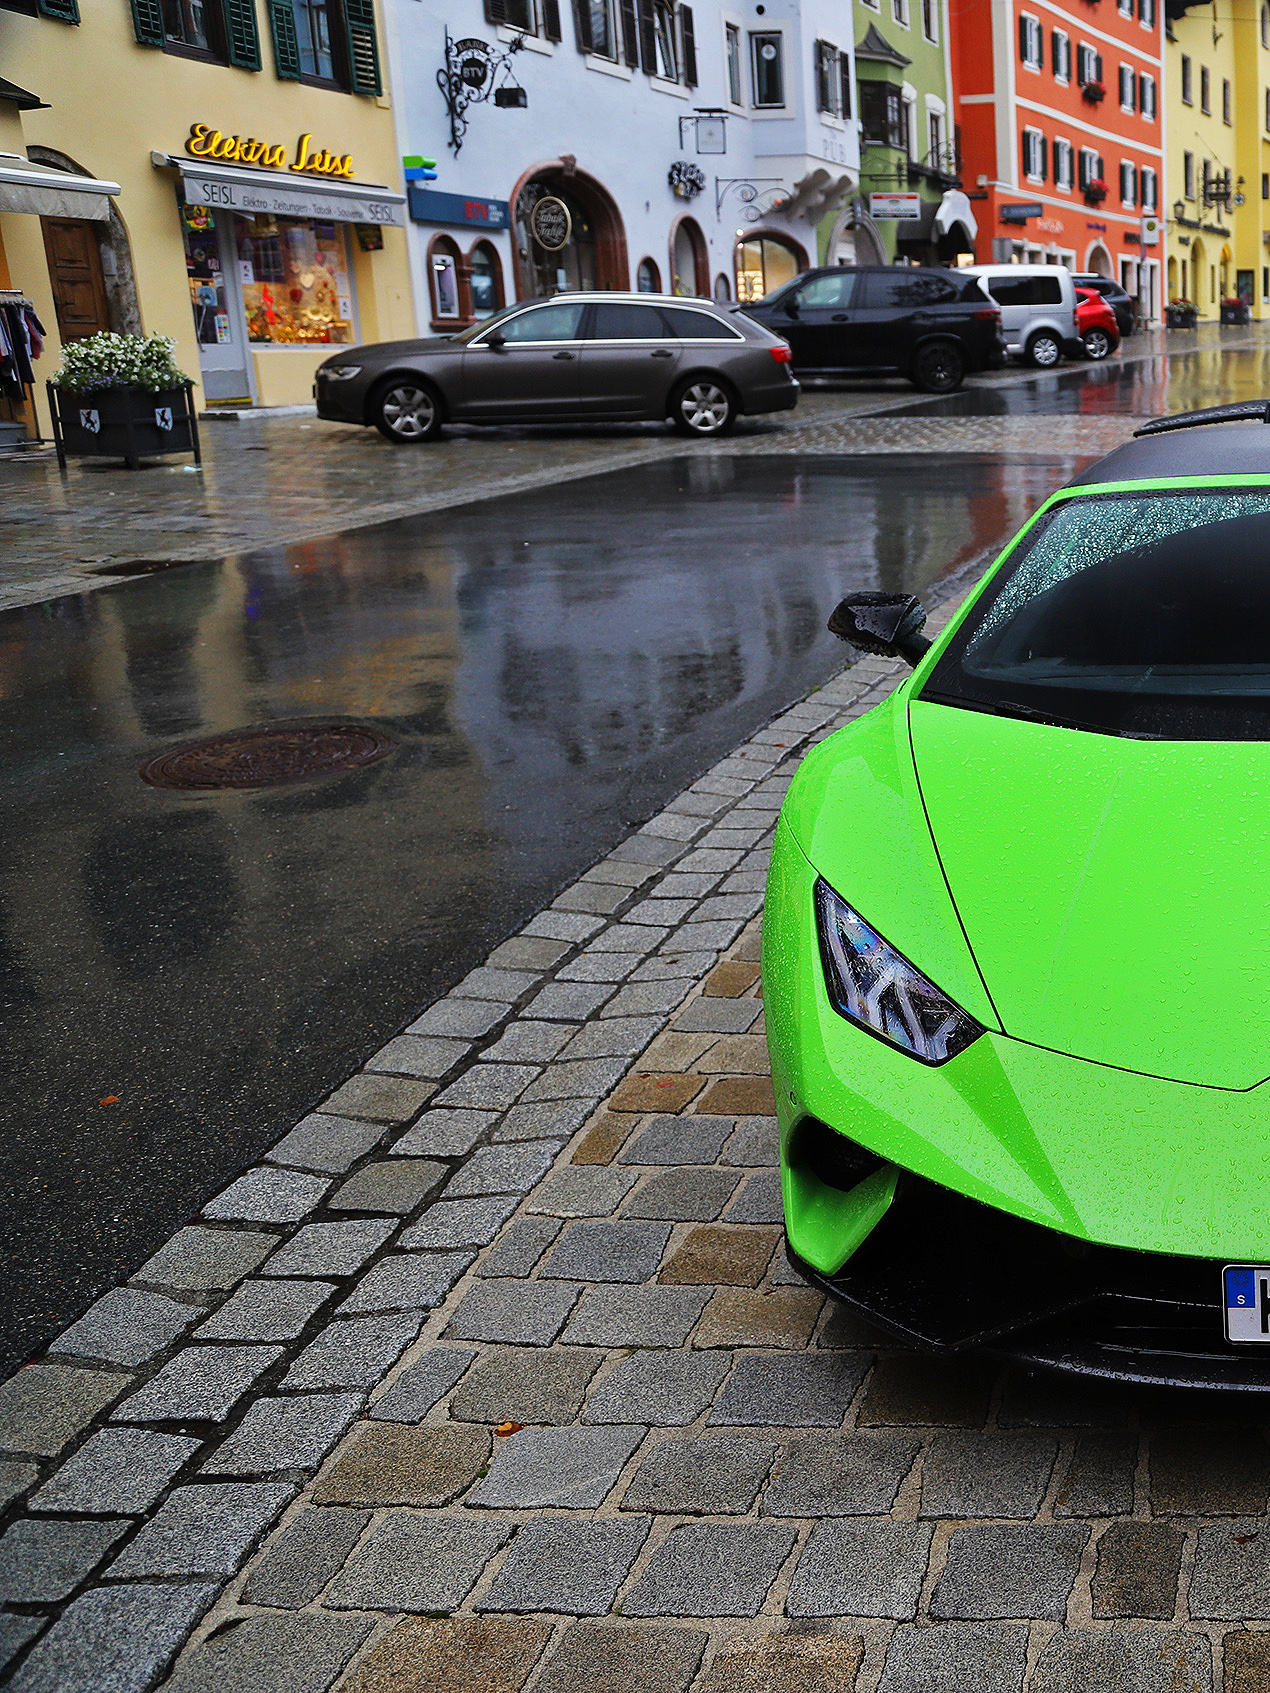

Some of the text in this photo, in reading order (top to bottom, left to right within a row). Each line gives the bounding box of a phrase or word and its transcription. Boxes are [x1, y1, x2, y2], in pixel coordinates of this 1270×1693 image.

[463, 67, 485, 78] BTV
[186, 124, 286, 167] Elektro
[203, 183, 237, 205] SEISL
[243, 196, 268, 209] Elektro
[273, 199, 308, 216] Zeitungen
[369, 204, 396, 222] SEISL
[464, 201, 489, 221] BTV
[1237, 1294, 1246, 1305] S
